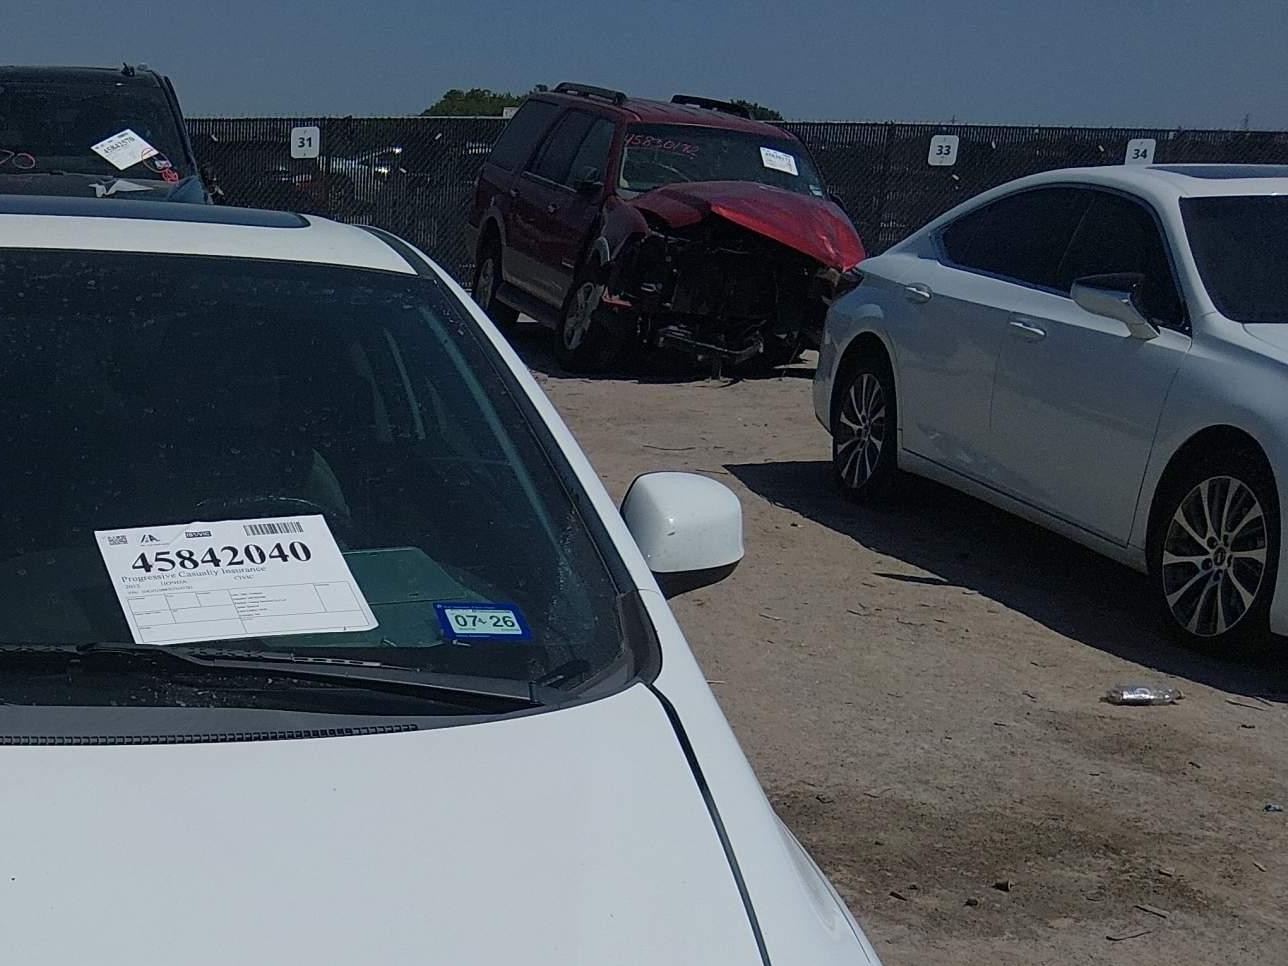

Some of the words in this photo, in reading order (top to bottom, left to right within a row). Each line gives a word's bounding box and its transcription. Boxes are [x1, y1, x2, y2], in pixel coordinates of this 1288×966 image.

[298, 136, 313, 148] 31
[936, 144, 952, 156] 33
[1132, 148, 1148, 160] 34
[131, 541, 312, 574] 45842040
[121, 572, 176, 585] Progressive
[178, 569, 220, 580] Casualty
[221, 566, 267, 576] Insurance
